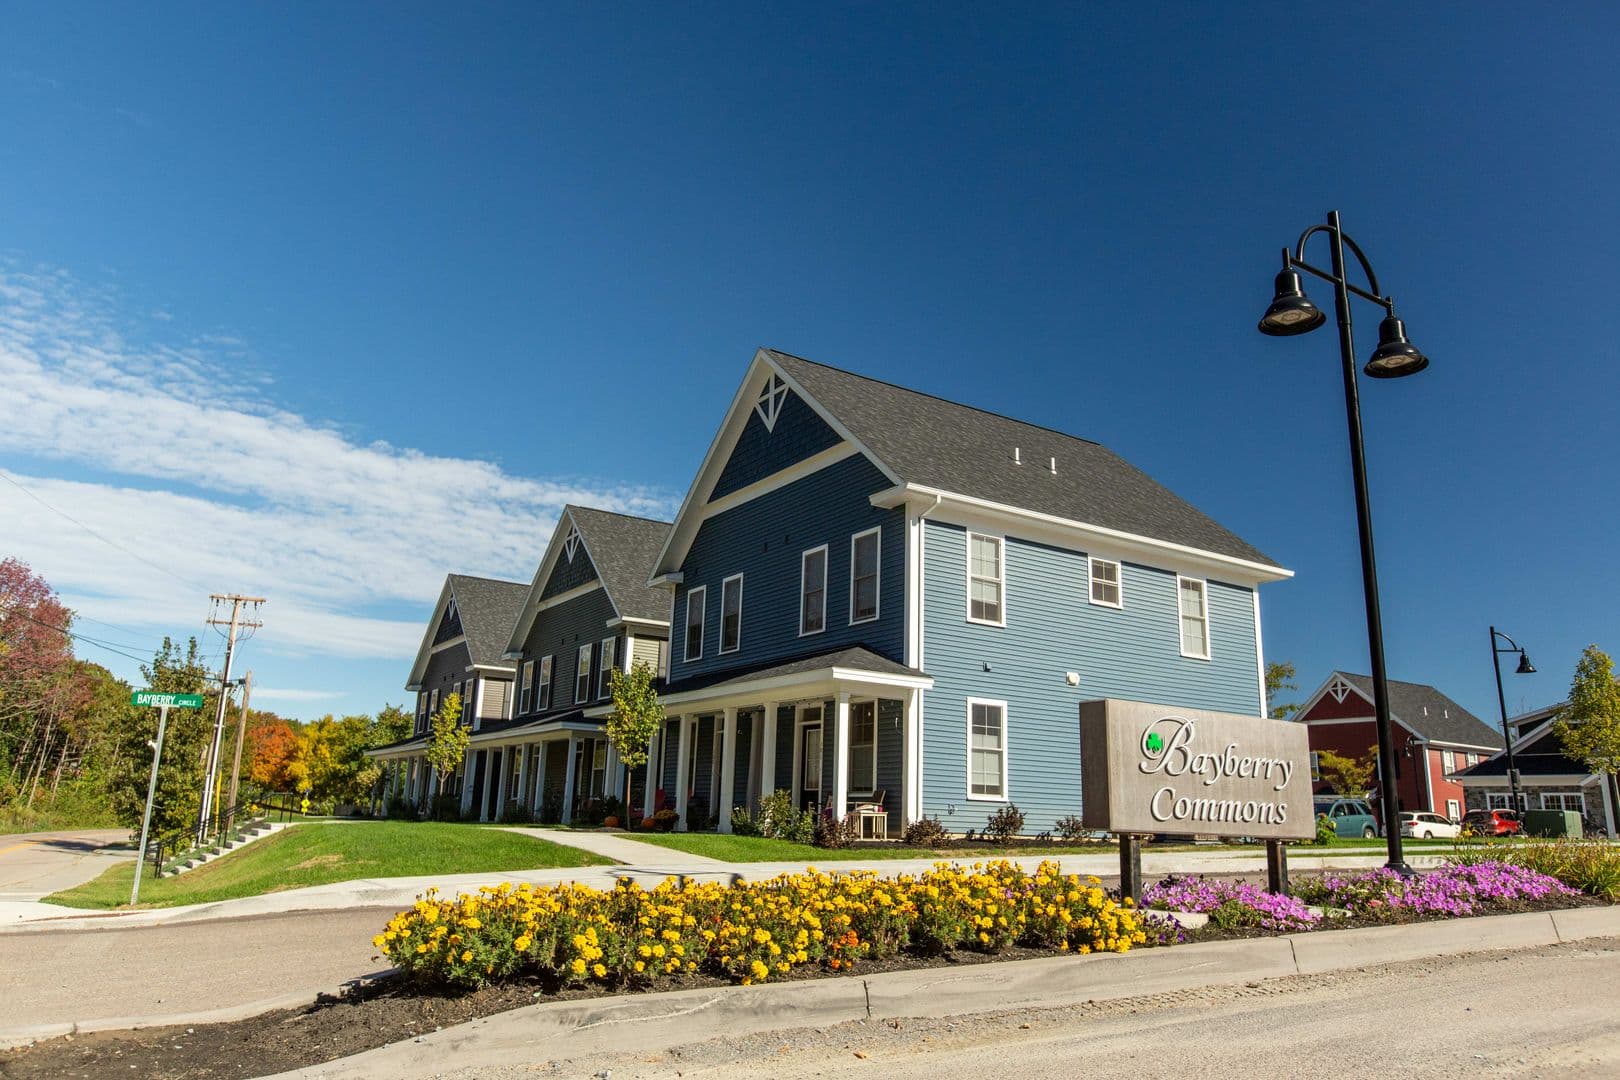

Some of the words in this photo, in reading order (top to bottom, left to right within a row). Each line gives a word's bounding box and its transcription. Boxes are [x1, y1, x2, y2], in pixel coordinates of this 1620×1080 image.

[137, 694, 176, 705] BAYBERRY
[1139, 715, 1292, 790] Bayberry
[1151, 787, 1287, 824] Commons
